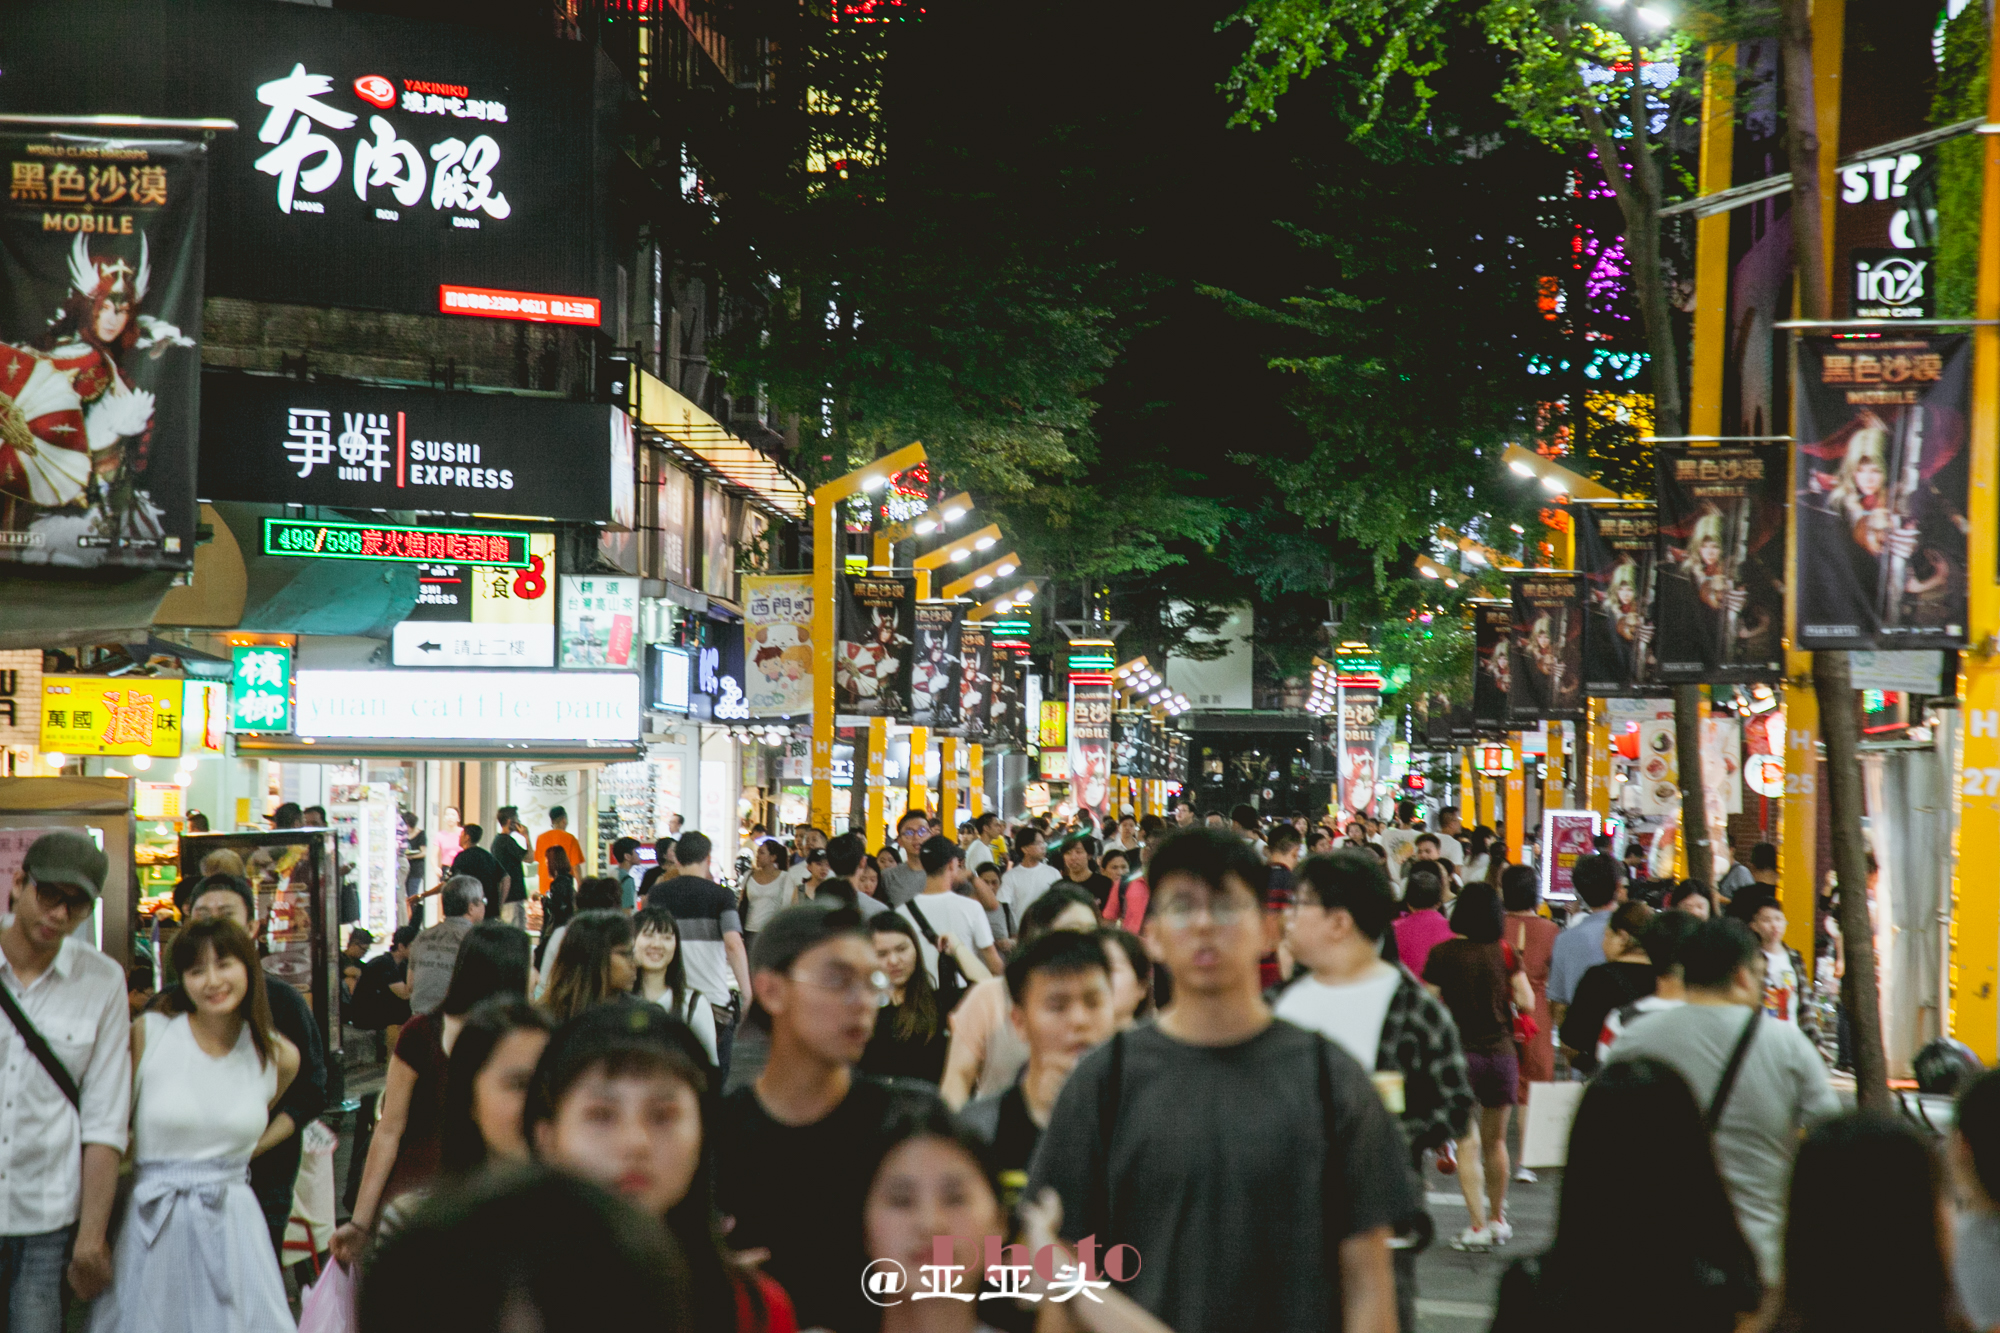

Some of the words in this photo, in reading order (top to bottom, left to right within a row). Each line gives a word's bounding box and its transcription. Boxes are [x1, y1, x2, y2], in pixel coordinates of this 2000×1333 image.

[404, 79, 468, 98] YAKINIKU
[254, 62, 511, 219] 夯肉殿
[11, 162, 167, 206] 黑色沙漠
[43, 213, 134, 235] MOBILE
[1822, 354, 1943, 384] 黑色沙漠
[1846, 390, 1917, 405] MOBILE
[282, 408, 391, 481] 爭鮮
[410, 440, 481, 464] SUSHI
[410, 464, 514, 490] EXPRESS
[1675, 458, 1764, 481] 黑色沙漠
[1694, 487, 1746, 497] MOBILE
[854, 582, 905, 599] 黑色沙漠
[1523, 584, 1576, 597] 黑色沙漠
[568, 597, 633, 611] 台灣高山茶
[752, 597, 814, 615] 西門町
[863, 600, 893, 608] MOBILE
[455, 639, 526, 656] 請上二樓
[237, 651, 285, 726] 檳榔
[310, 697, 386, 721] yuan
[411, 691, 531, 718] cattle
[47, 690, 178, 747] 萬國滷味
[1970, 709, 1999, 738] H
[816, 741, 828, 754] H
[1789, 730, 1810, 750] H
[872, 752, 883, 764] H
[913, 754, 924, 765] H
[1550, 757, 1560, 767] H
[1594, 750, 1607, 762] H
[813, 767, 831, 780] 22
[869, 775, 884, 787] 20
[1593, 776, 1609, 788] 21
[1962, 767, 2000, 797] 27
[1508, 780, 1522, 791] 17
[1549, 781, 1562, 791] 19
[1785, 773, 1815, 794] 25
